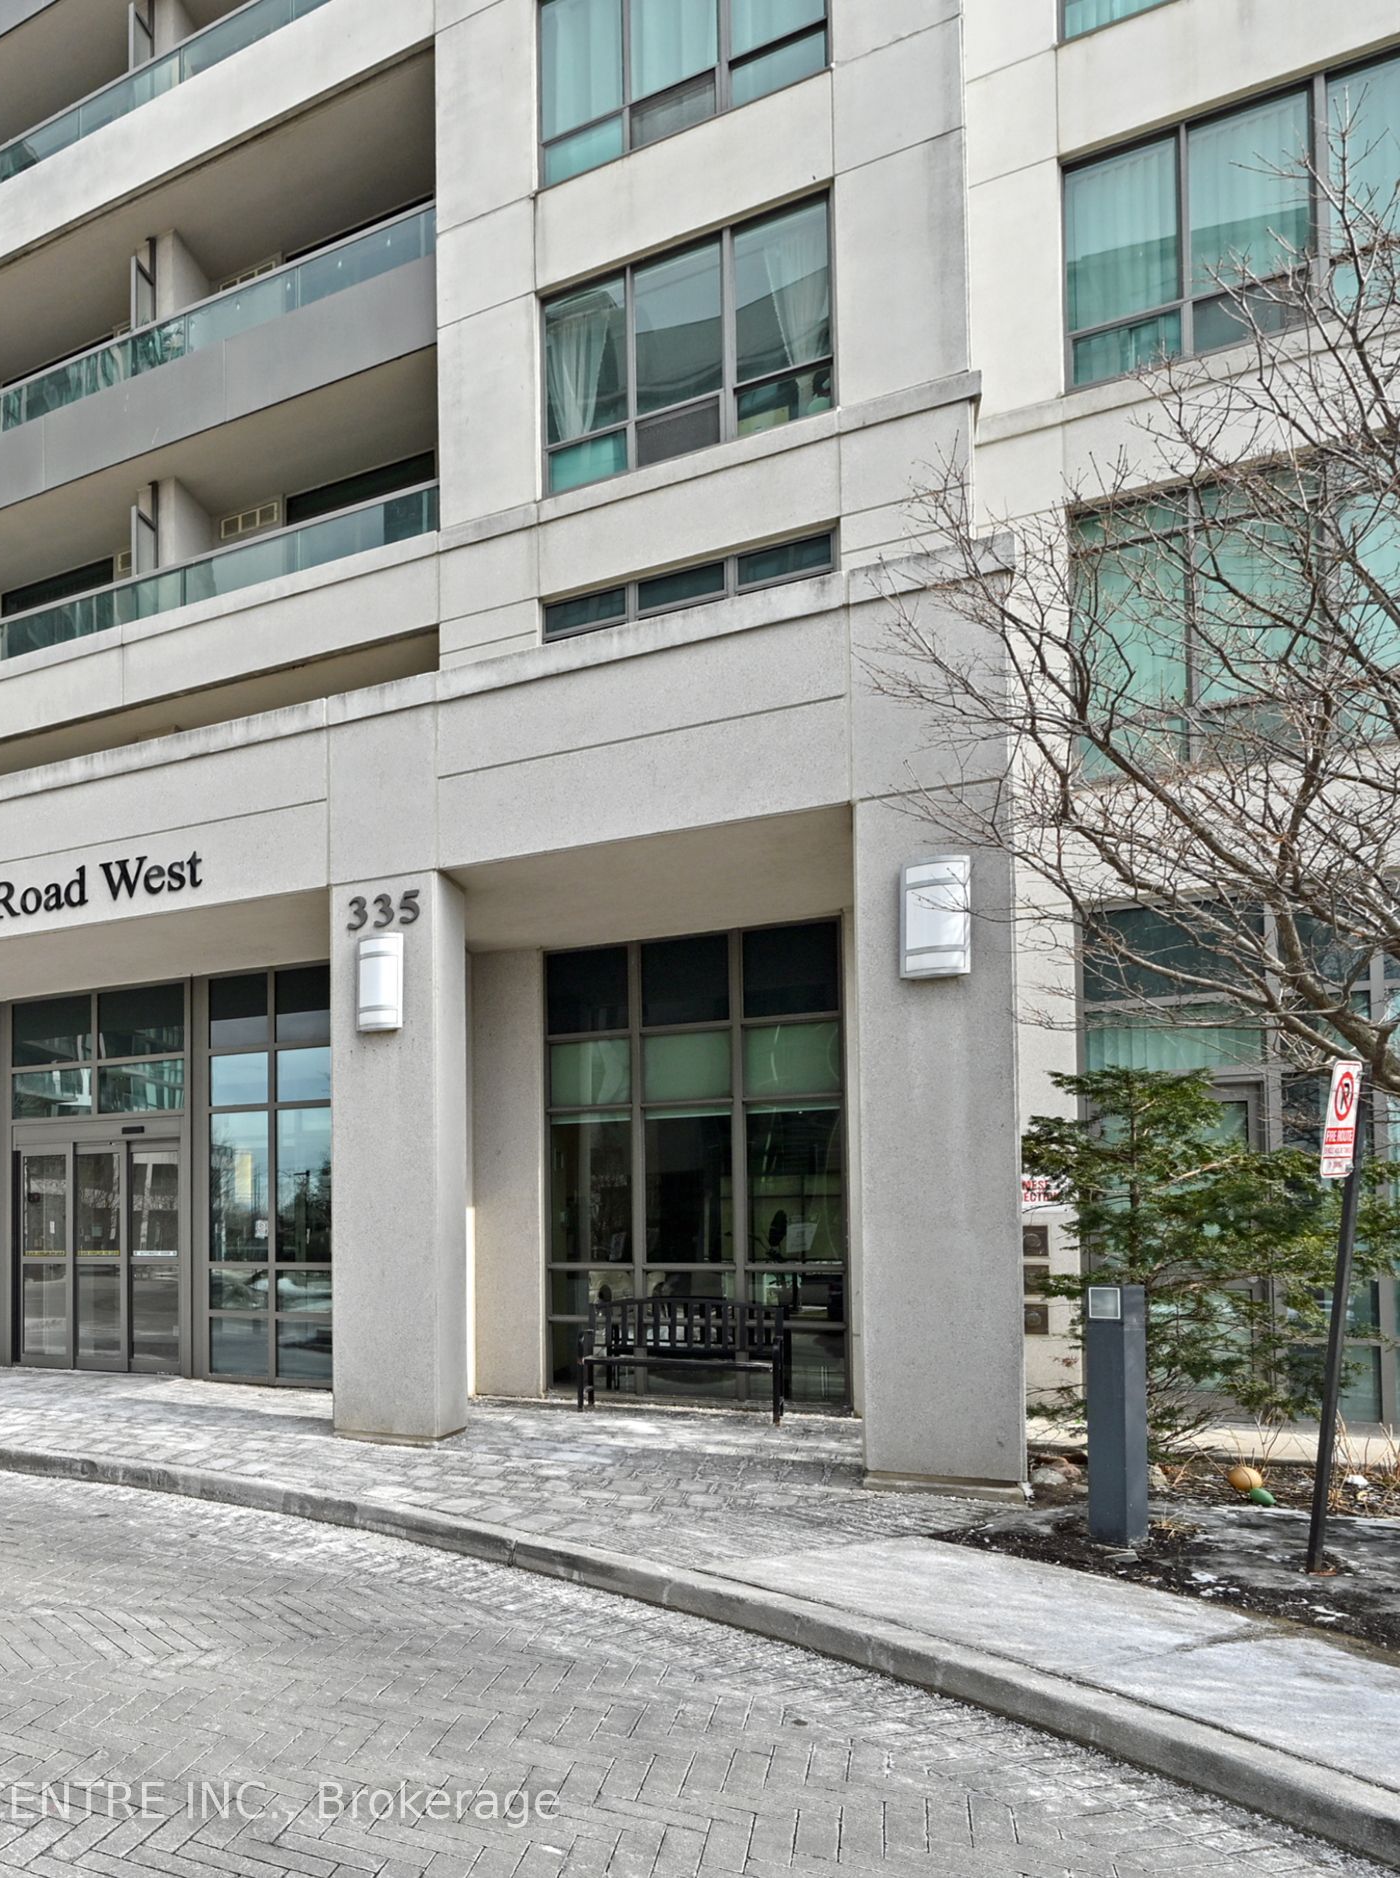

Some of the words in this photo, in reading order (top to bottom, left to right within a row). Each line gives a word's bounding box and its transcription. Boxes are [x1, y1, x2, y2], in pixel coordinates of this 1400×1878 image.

[99, 851, 203, 901] West
[347, 889, 420, 931] 335
[1325, 1130, 1338, 1142] FIRE
